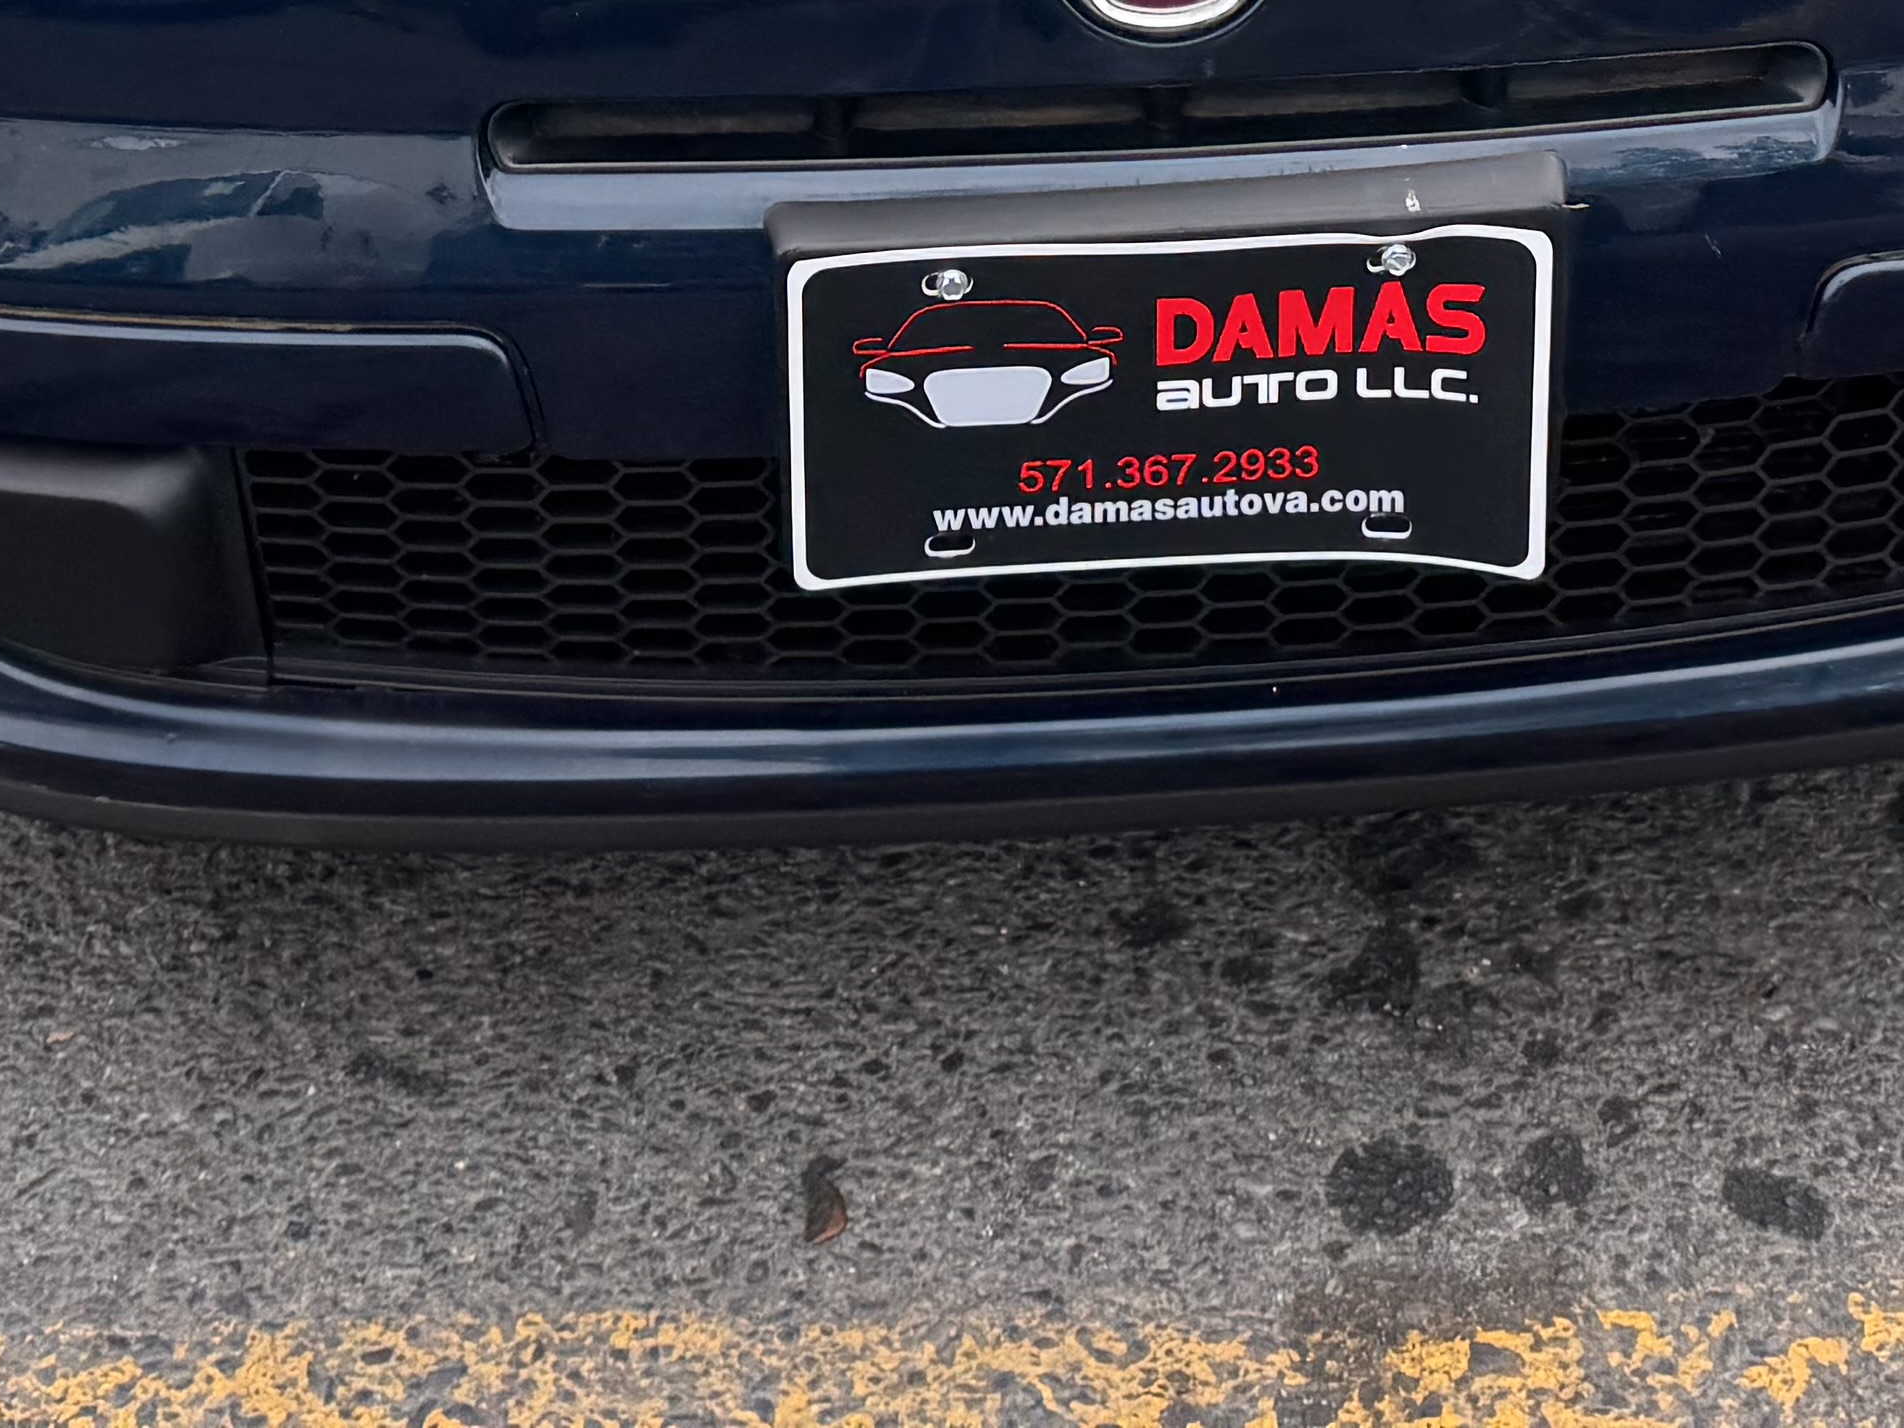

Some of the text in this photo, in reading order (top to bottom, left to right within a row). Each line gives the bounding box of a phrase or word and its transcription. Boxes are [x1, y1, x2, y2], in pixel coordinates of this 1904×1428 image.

[1154, 280, 1487, 367] DAMAS
[1355, 365, 1480, 404] LLC.
[1017, 445, 1320, 494] 571.367.2933
[933, 489, 1405, 531] www.damasautova.com
